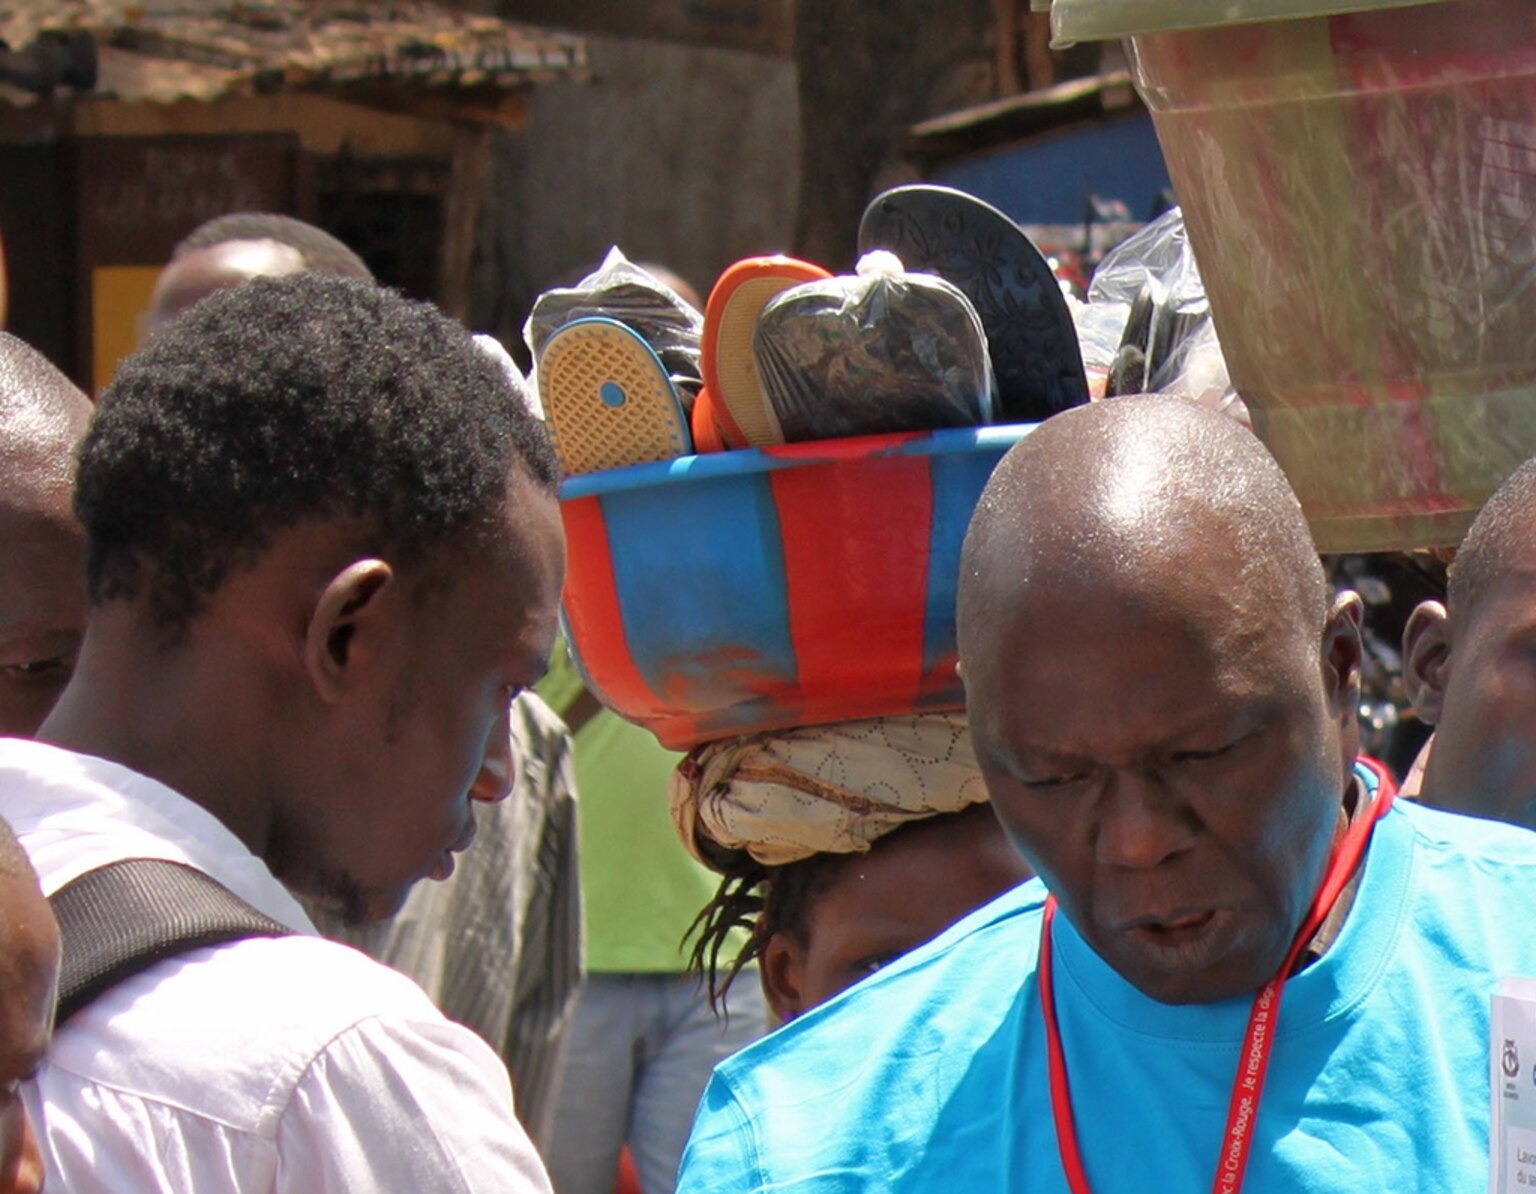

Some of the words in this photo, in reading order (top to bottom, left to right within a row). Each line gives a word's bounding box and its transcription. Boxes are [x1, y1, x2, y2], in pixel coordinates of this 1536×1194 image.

[1254, 1010, 1268, 1024] la
[1247, 1022, 1268, 1076] respecte
[1242, 1076, 1257, 1091] Je
[1222, 1172, 1237, 1186] la
